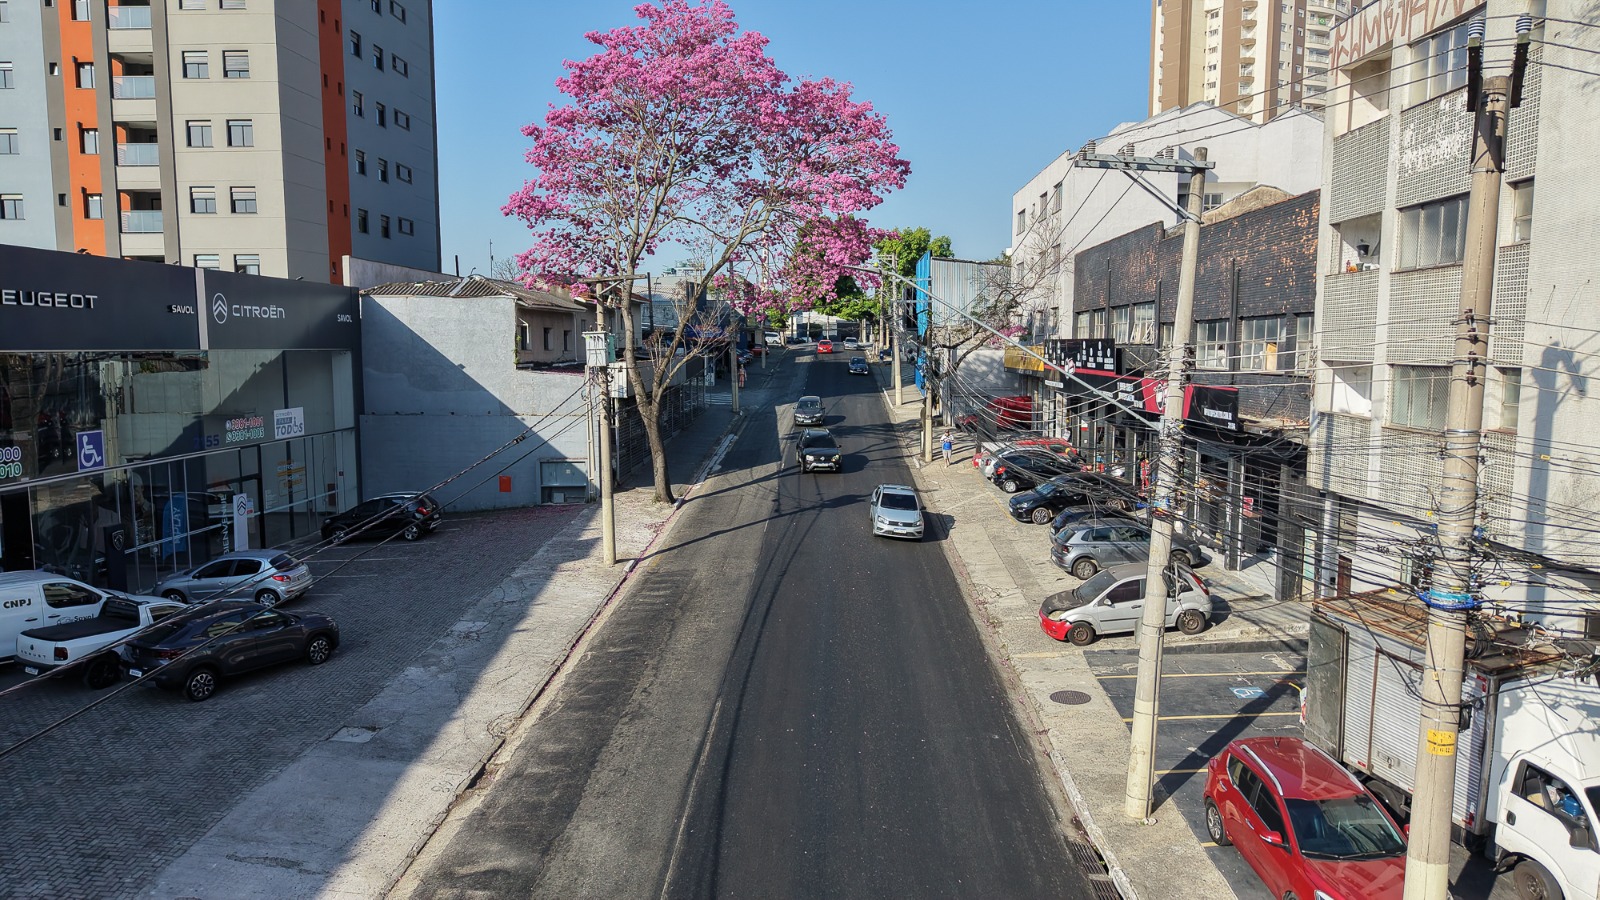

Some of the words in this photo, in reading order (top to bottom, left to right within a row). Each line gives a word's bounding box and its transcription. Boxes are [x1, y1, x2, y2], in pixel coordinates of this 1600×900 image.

[1, 289, 98, 309] EUGEOT
[171, 304, 195, 314] SAVOL
[337, 314, 353, 323] SAVOL
[3, 598, 32, 609] CNPJ
